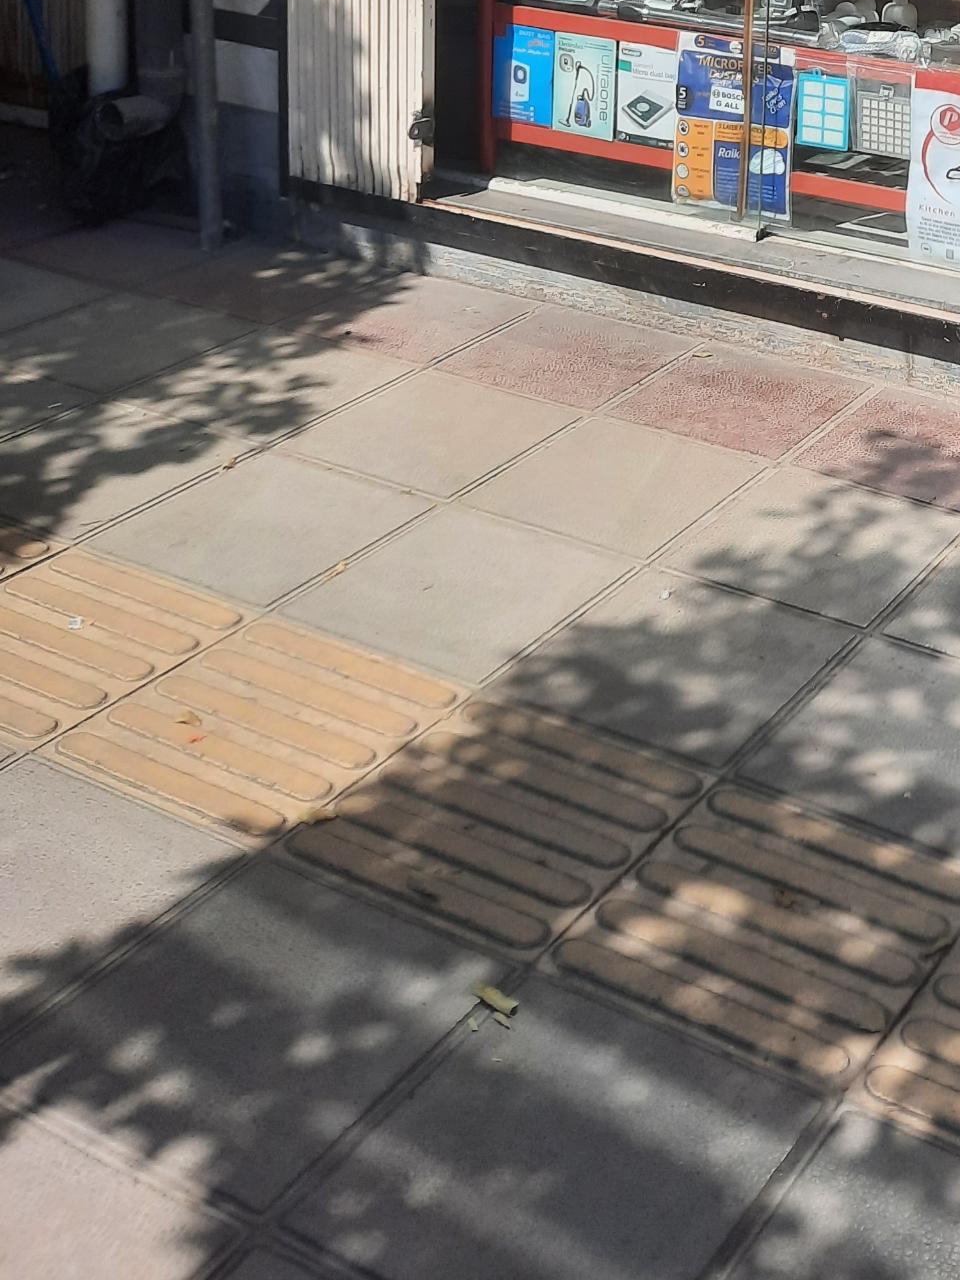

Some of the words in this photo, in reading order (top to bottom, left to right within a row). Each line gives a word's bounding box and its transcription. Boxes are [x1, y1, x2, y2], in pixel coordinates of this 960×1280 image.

[679, 87, 687, 99] 5
[724, 102, 740, 110] ALL
[918, 204, 956, 217] Kitchen
